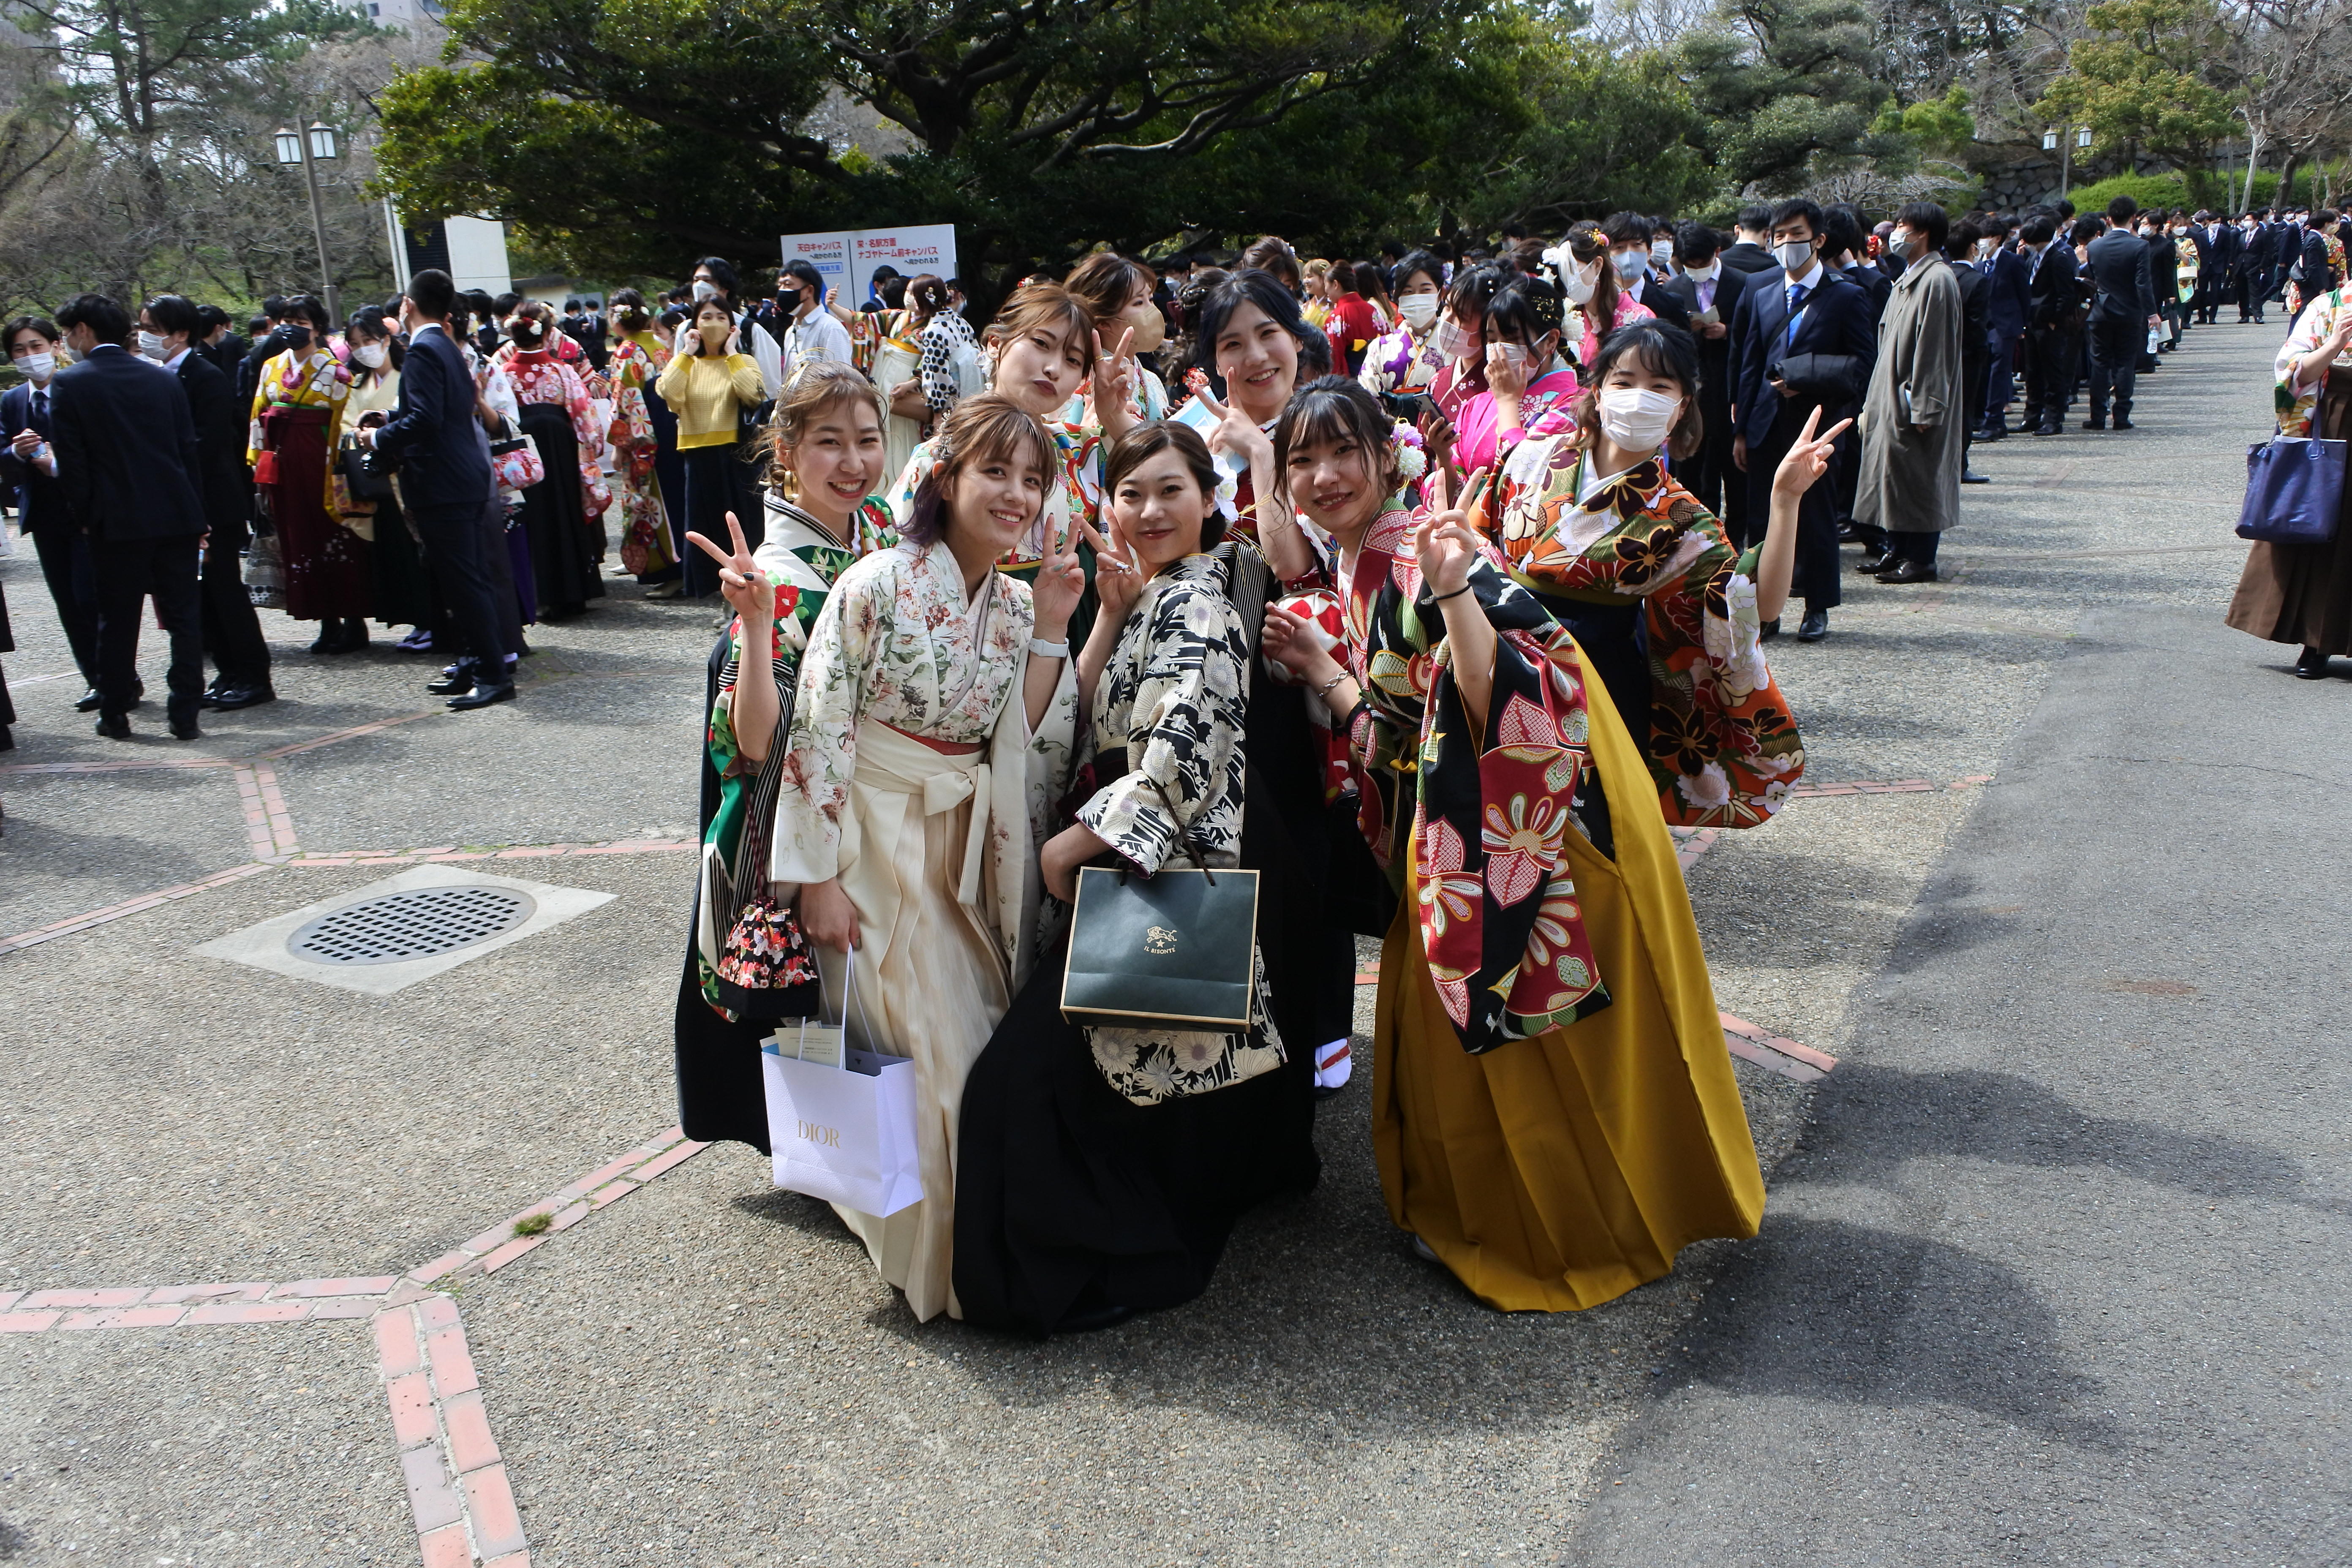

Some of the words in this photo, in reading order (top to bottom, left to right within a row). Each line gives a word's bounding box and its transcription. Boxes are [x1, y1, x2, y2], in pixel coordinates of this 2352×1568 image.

[858, 247, 938, 259] ナゴヤドーム前キャンパス
[798, 1120, 841, 1149] DIOR
